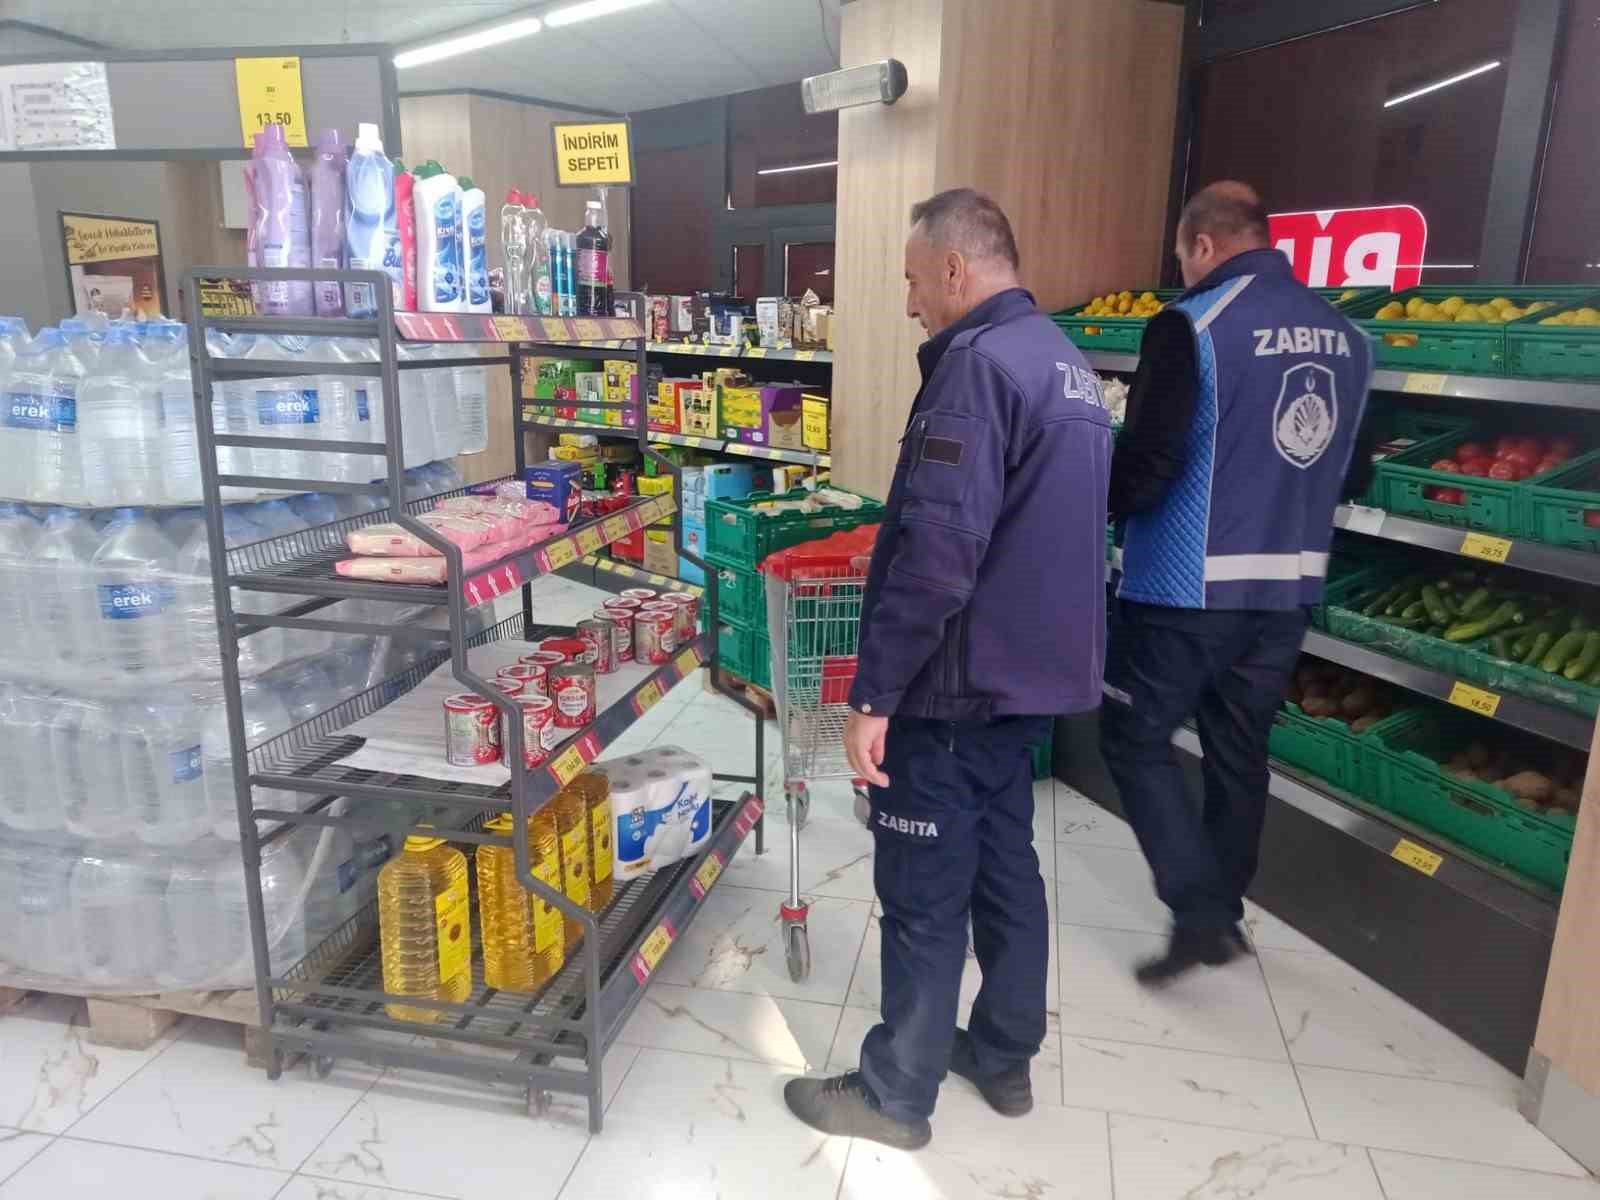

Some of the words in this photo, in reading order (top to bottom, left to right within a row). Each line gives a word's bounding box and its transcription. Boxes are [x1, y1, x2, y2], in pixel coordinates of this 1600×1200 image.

[562, 131, 619, 151] İNDİRİM
[567, 152, 619, 172] SEPETİ
[1253, 326, 1351, 358] ZABITA
[11, 403, 49, 418] erek
[275, 399, 310, 413] erek
[112, 592, 153, 608] erek
[878, 810, 939, 837] ZABITA
